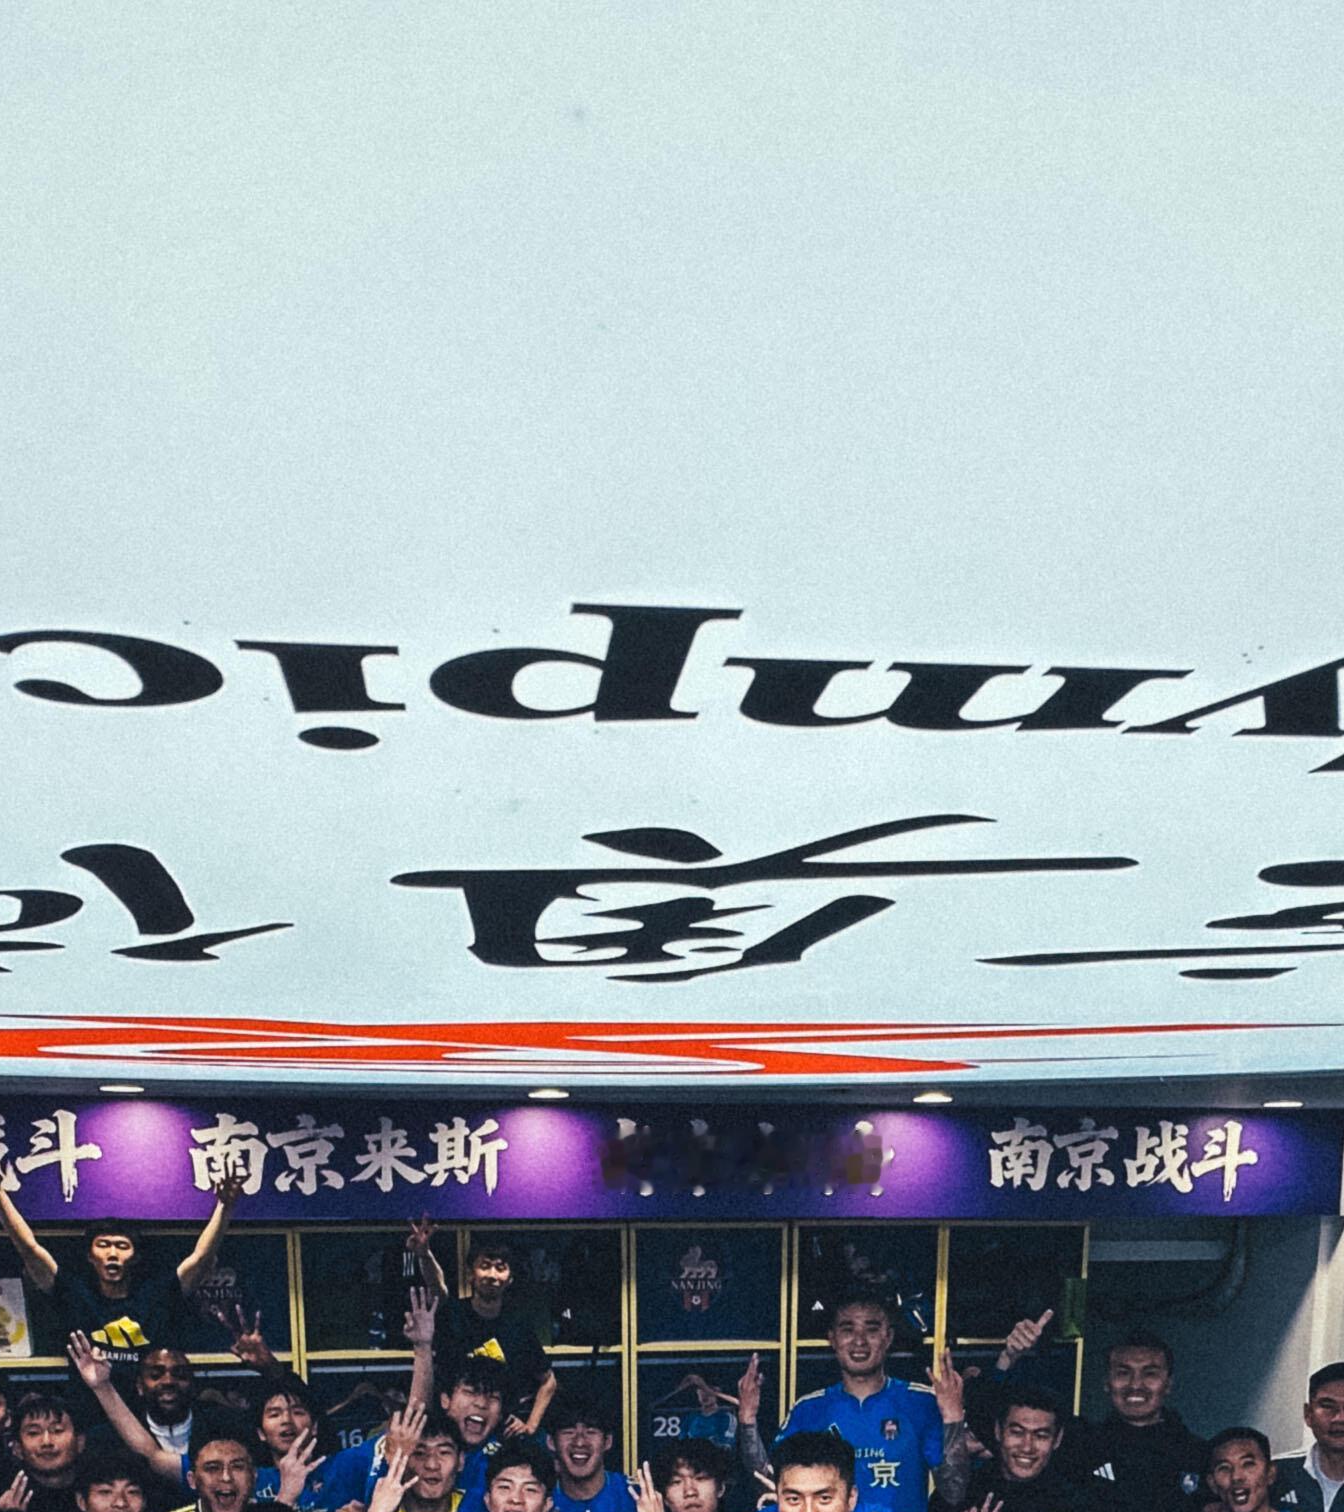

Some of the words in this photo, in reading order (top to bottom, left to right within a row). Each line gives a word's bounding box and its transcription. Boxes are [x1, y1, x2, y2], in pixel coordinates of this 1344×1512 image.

[188, 1112, 509, 1197] 南京来斯
[989, 1118, 1258, 1203] 南京战斗
[195, 1288, 242, 1299] ANJING
[671, 1280, 722, 1290] NANJING
[653, 1416, 681, 1437] 28
[338, 1428, 362, 1448] 16
[867, 1459, 901, 1488] 京
